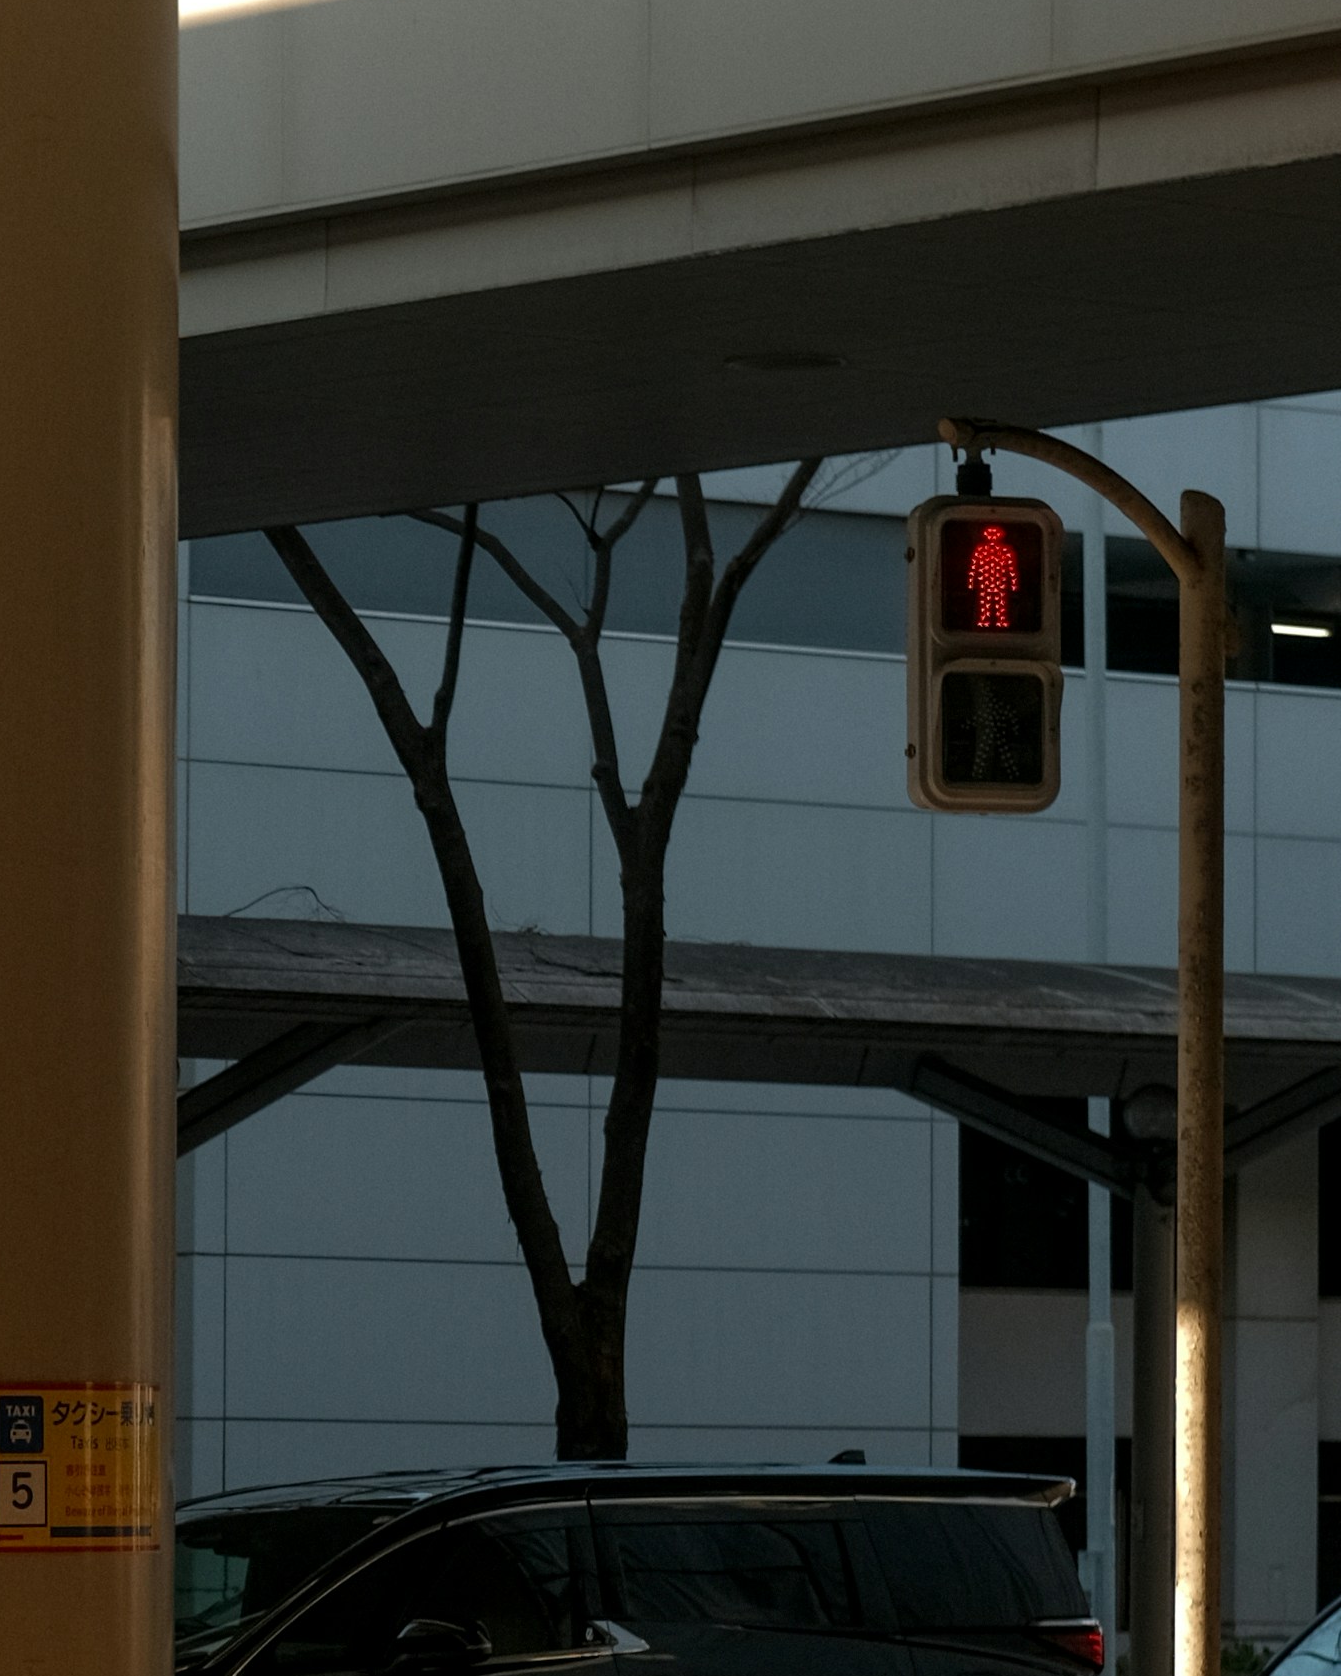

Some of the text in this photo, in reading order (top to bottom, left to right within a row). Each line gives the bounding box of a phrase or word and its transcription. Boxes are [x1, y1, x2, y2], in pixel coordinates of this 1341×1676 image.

[5, 1404, 36, 1417] TAXI
[12, 1472, 33, 1510] 5
[64, 1505, 98, 1519] Bewe
